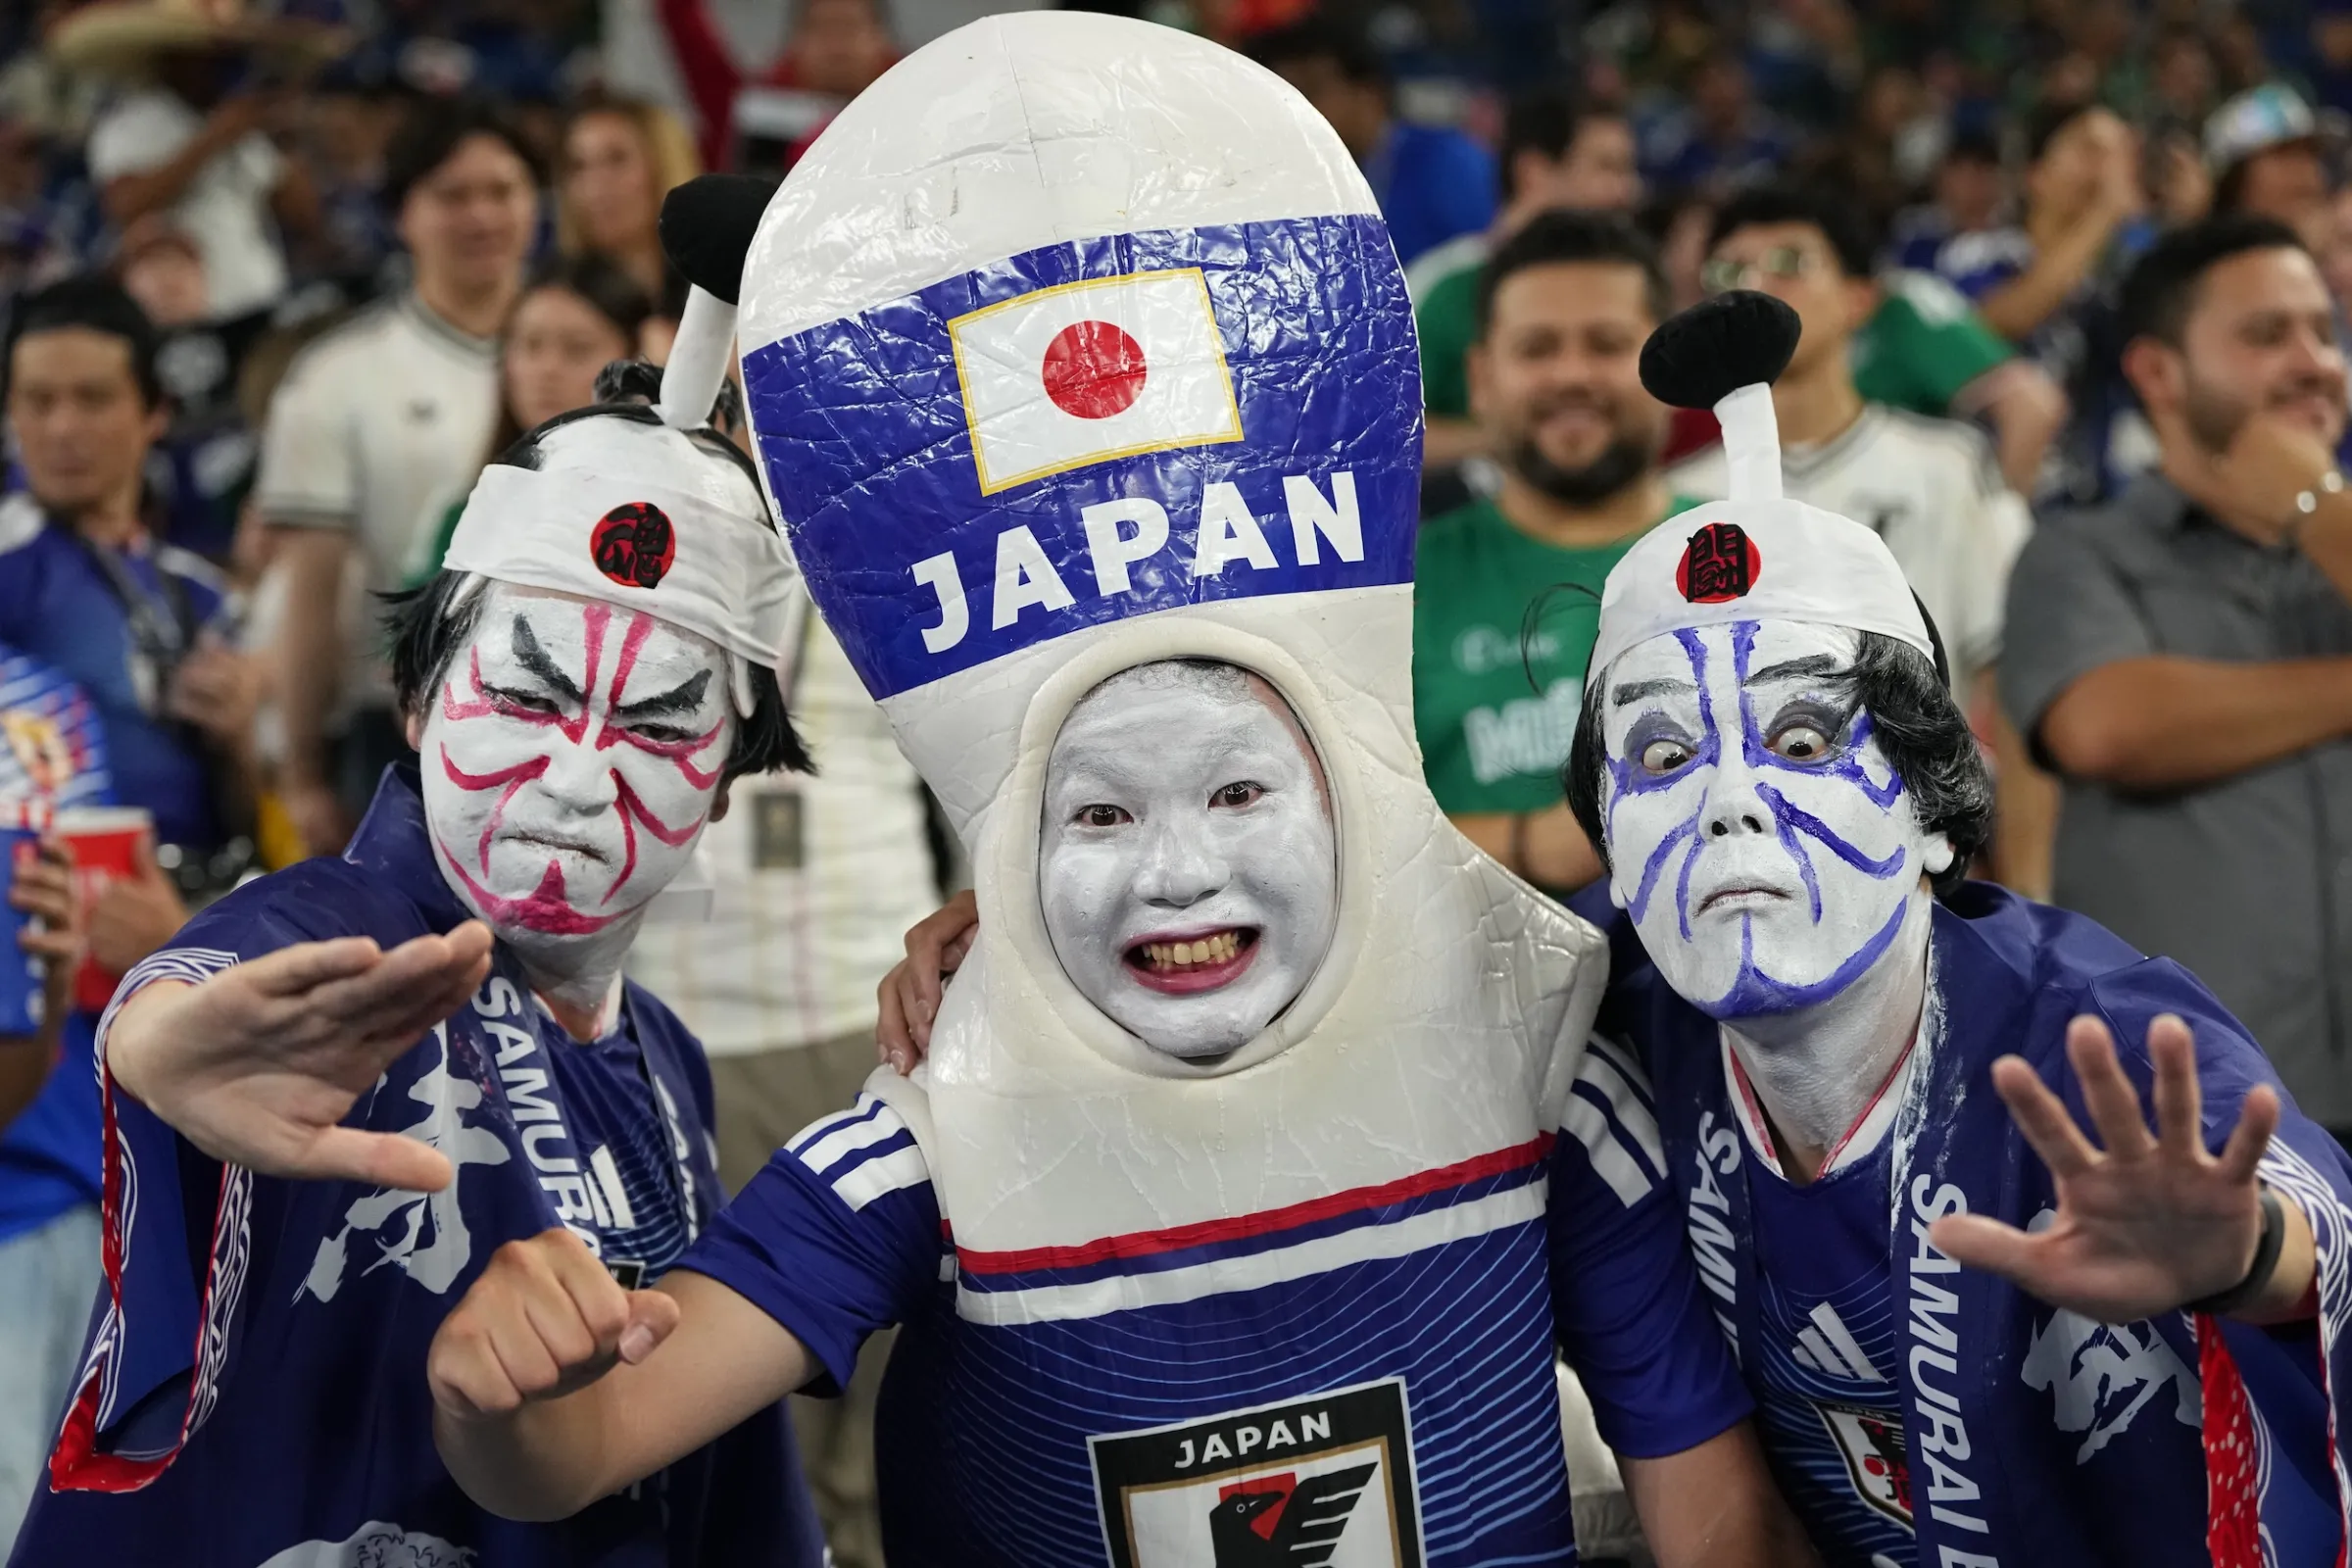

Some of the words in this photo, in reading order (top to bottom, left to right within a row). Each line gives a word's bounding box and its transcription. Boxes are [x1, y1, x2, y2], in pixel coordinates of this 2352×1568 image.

[911, 471, 1365, 654] JAPAN
[1174, 1411, 1331, 1469] JAPAN
[1909, 1173, 1990, 1535] SAMURAI
